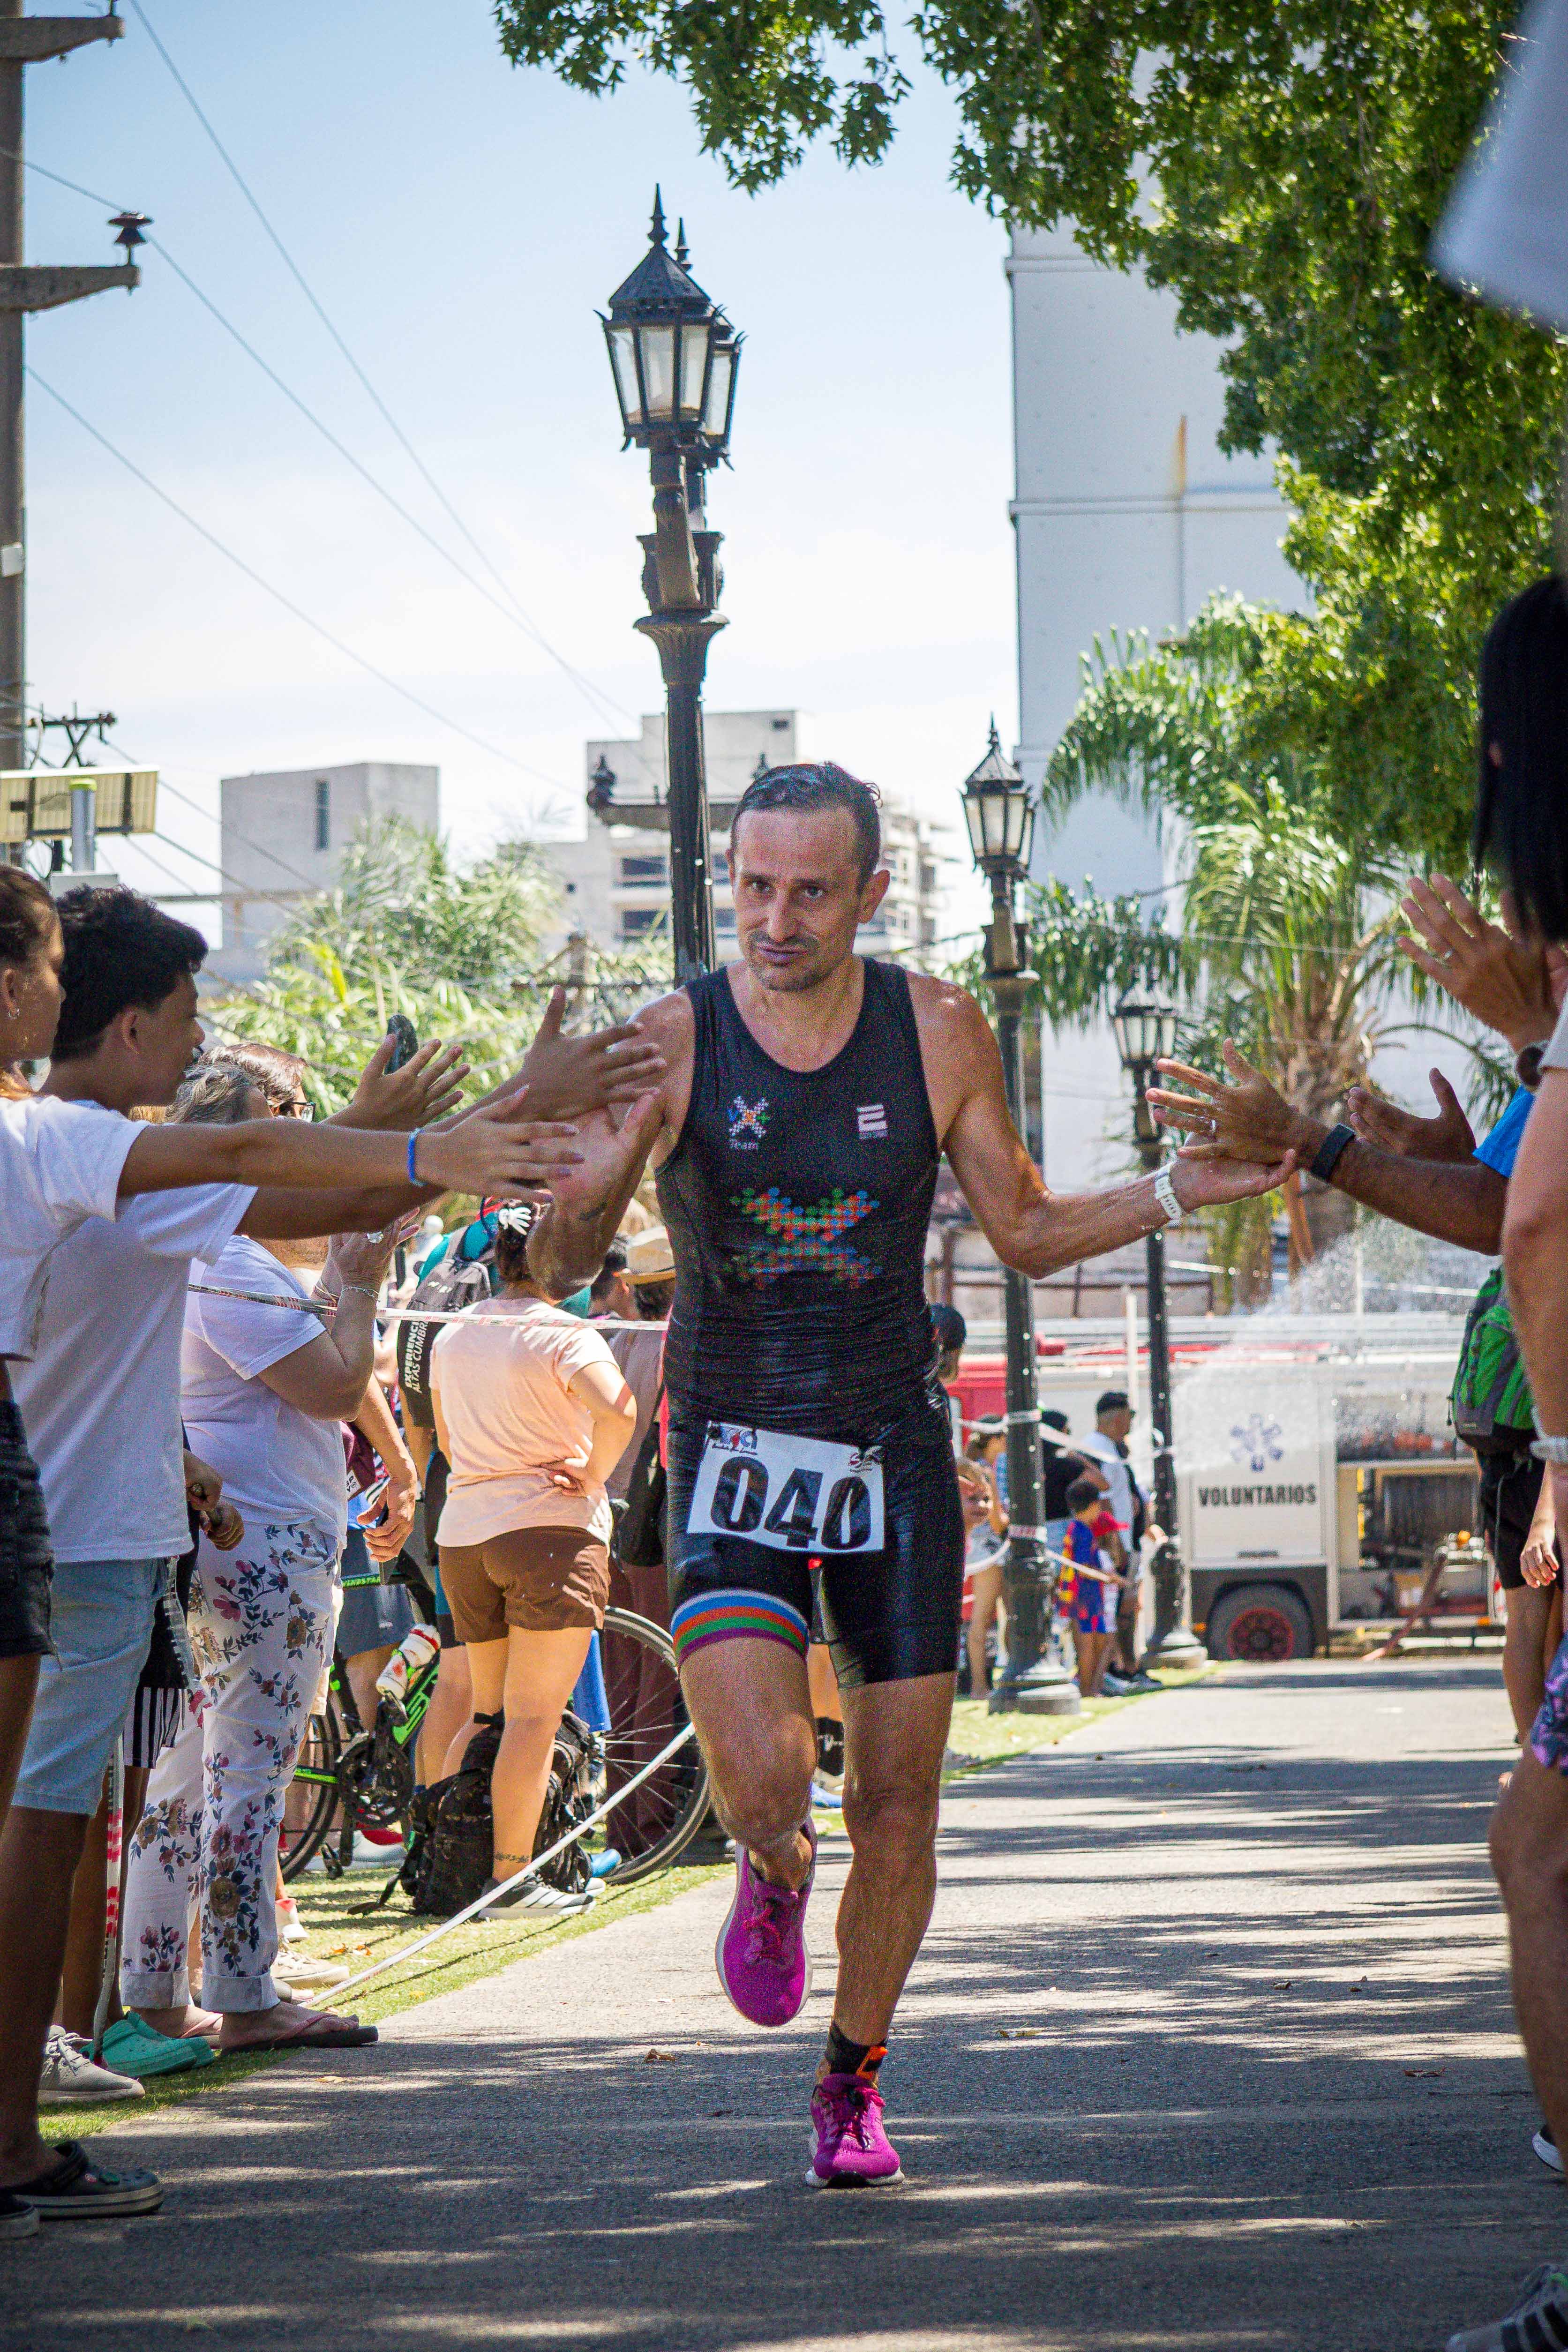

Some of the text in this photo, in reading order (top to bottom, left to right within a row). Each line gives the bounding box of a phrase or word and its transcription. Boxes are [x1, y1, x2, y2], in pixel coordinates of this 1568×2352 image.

[411, 1363, 422, 1394] ALTAS
[710, 1456, 872, 1551] 040
[1197, 1483, 1317, 1506] VOLUNTARIOS
